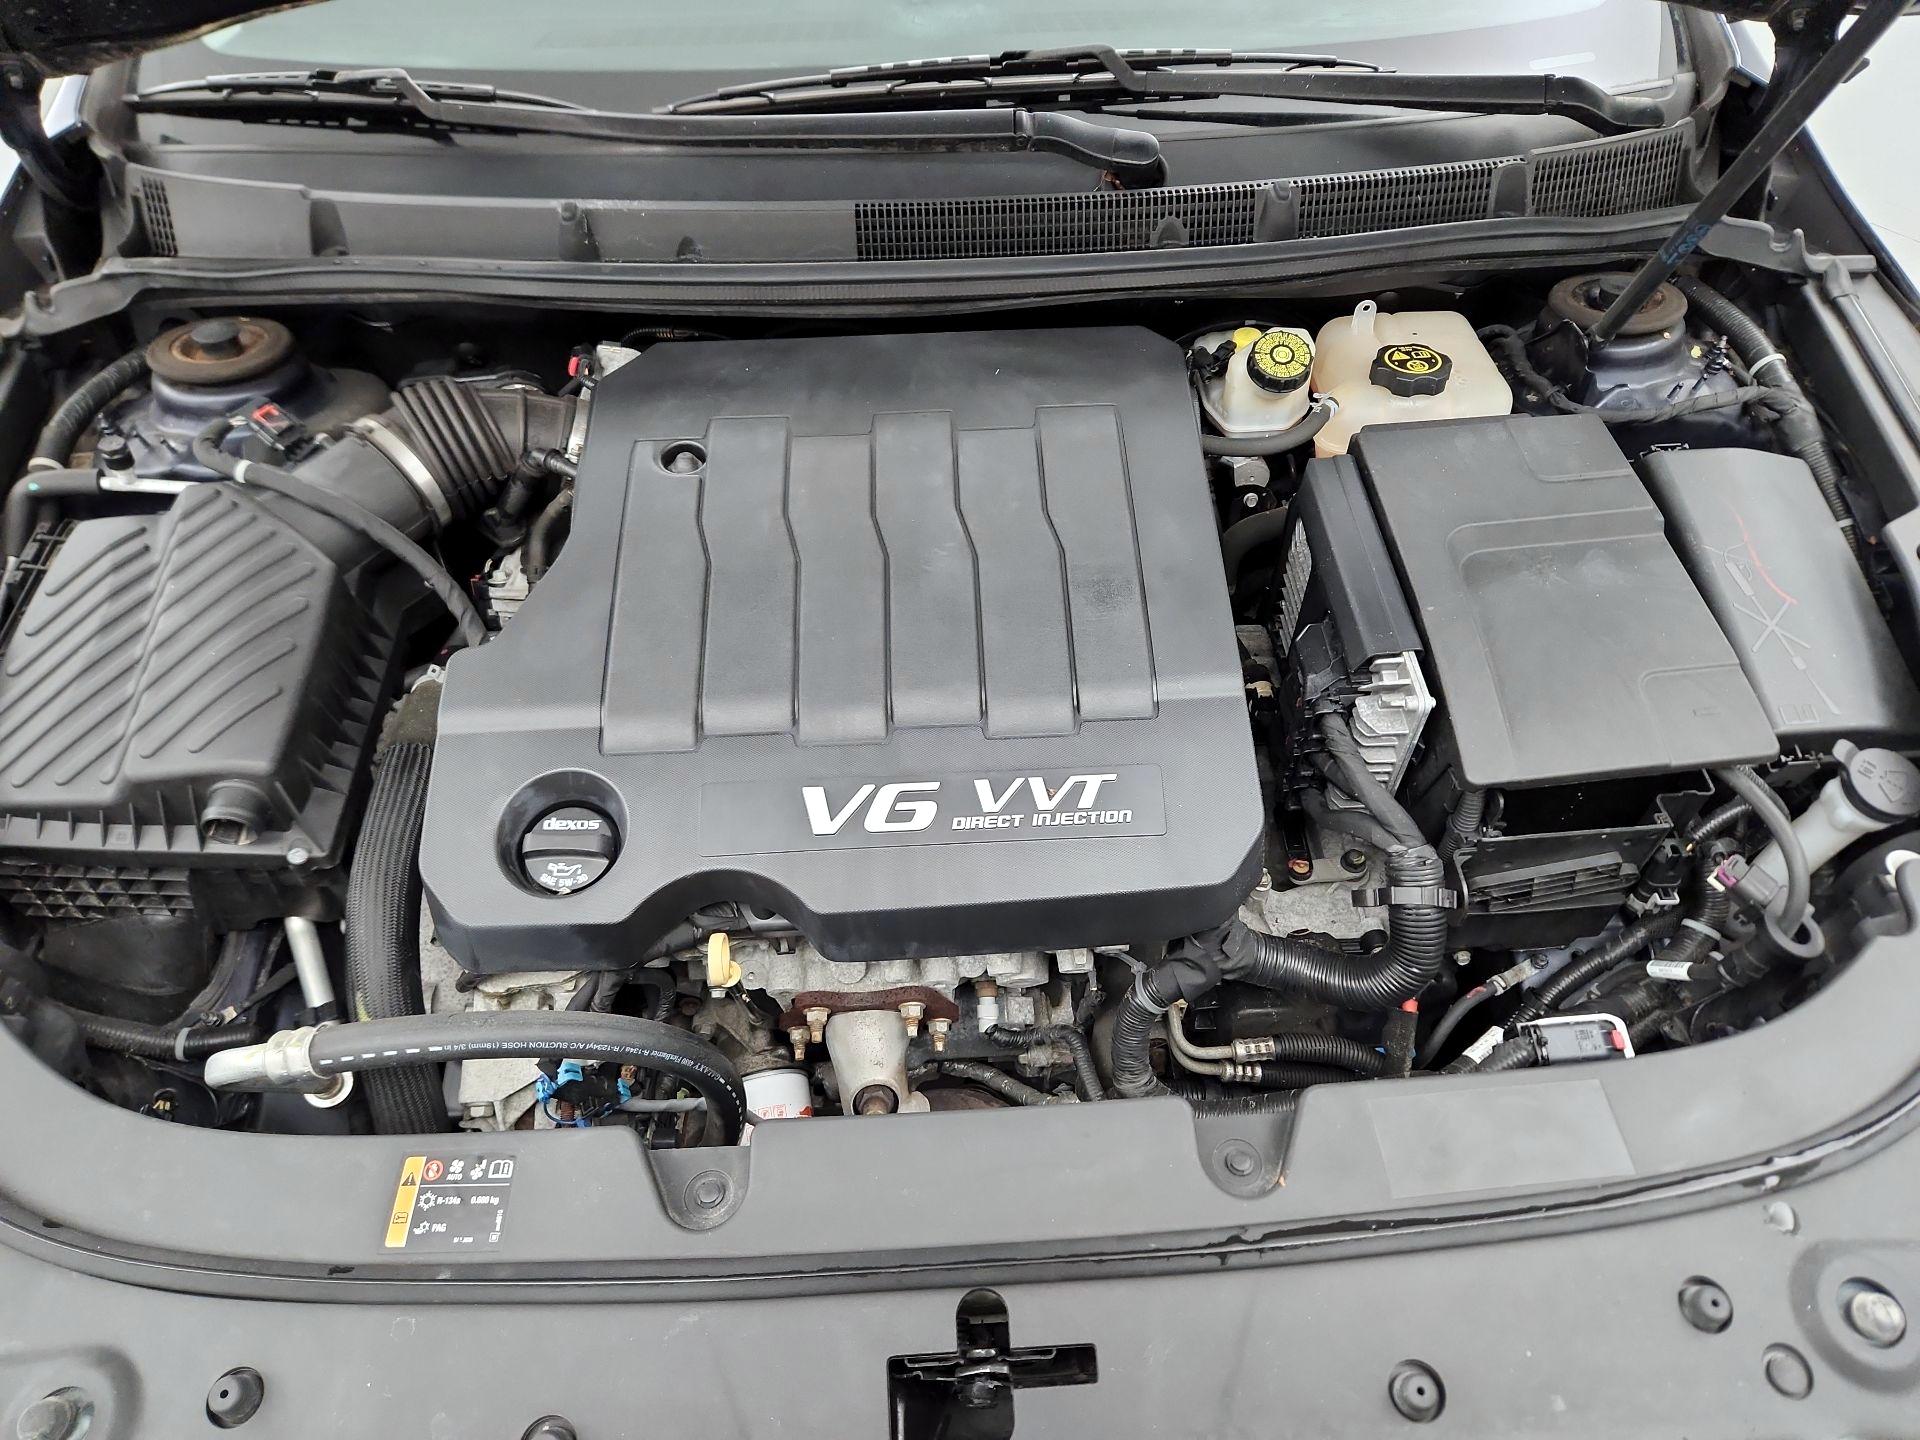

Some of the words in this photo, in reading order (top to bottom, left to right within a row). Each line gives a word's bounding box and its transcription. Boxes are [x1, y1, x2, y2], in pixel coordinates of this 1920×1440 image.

[802, 781, 941, 836] V6
[973, 773, 1119, 814] VVT
[542, 817, 602, 831] dexos
[952, 813, 1024, 831] DIRECT
[1032, 809, 1133, 828] INJECTION
[540, 873, 557, 886] SAE
[453, 1043, 466, 1051] 3/4
[468, 1041, 499, 1050] (19mm)
[501, 1041, 527, 1049] HOSE
[529, 1041, 569, 1049] SUCTION
[570, 1042, 585, 1050] A/C
[446, 1173, 463, 1181] AUTO
[432, 1223, 447, 1233] PAG
